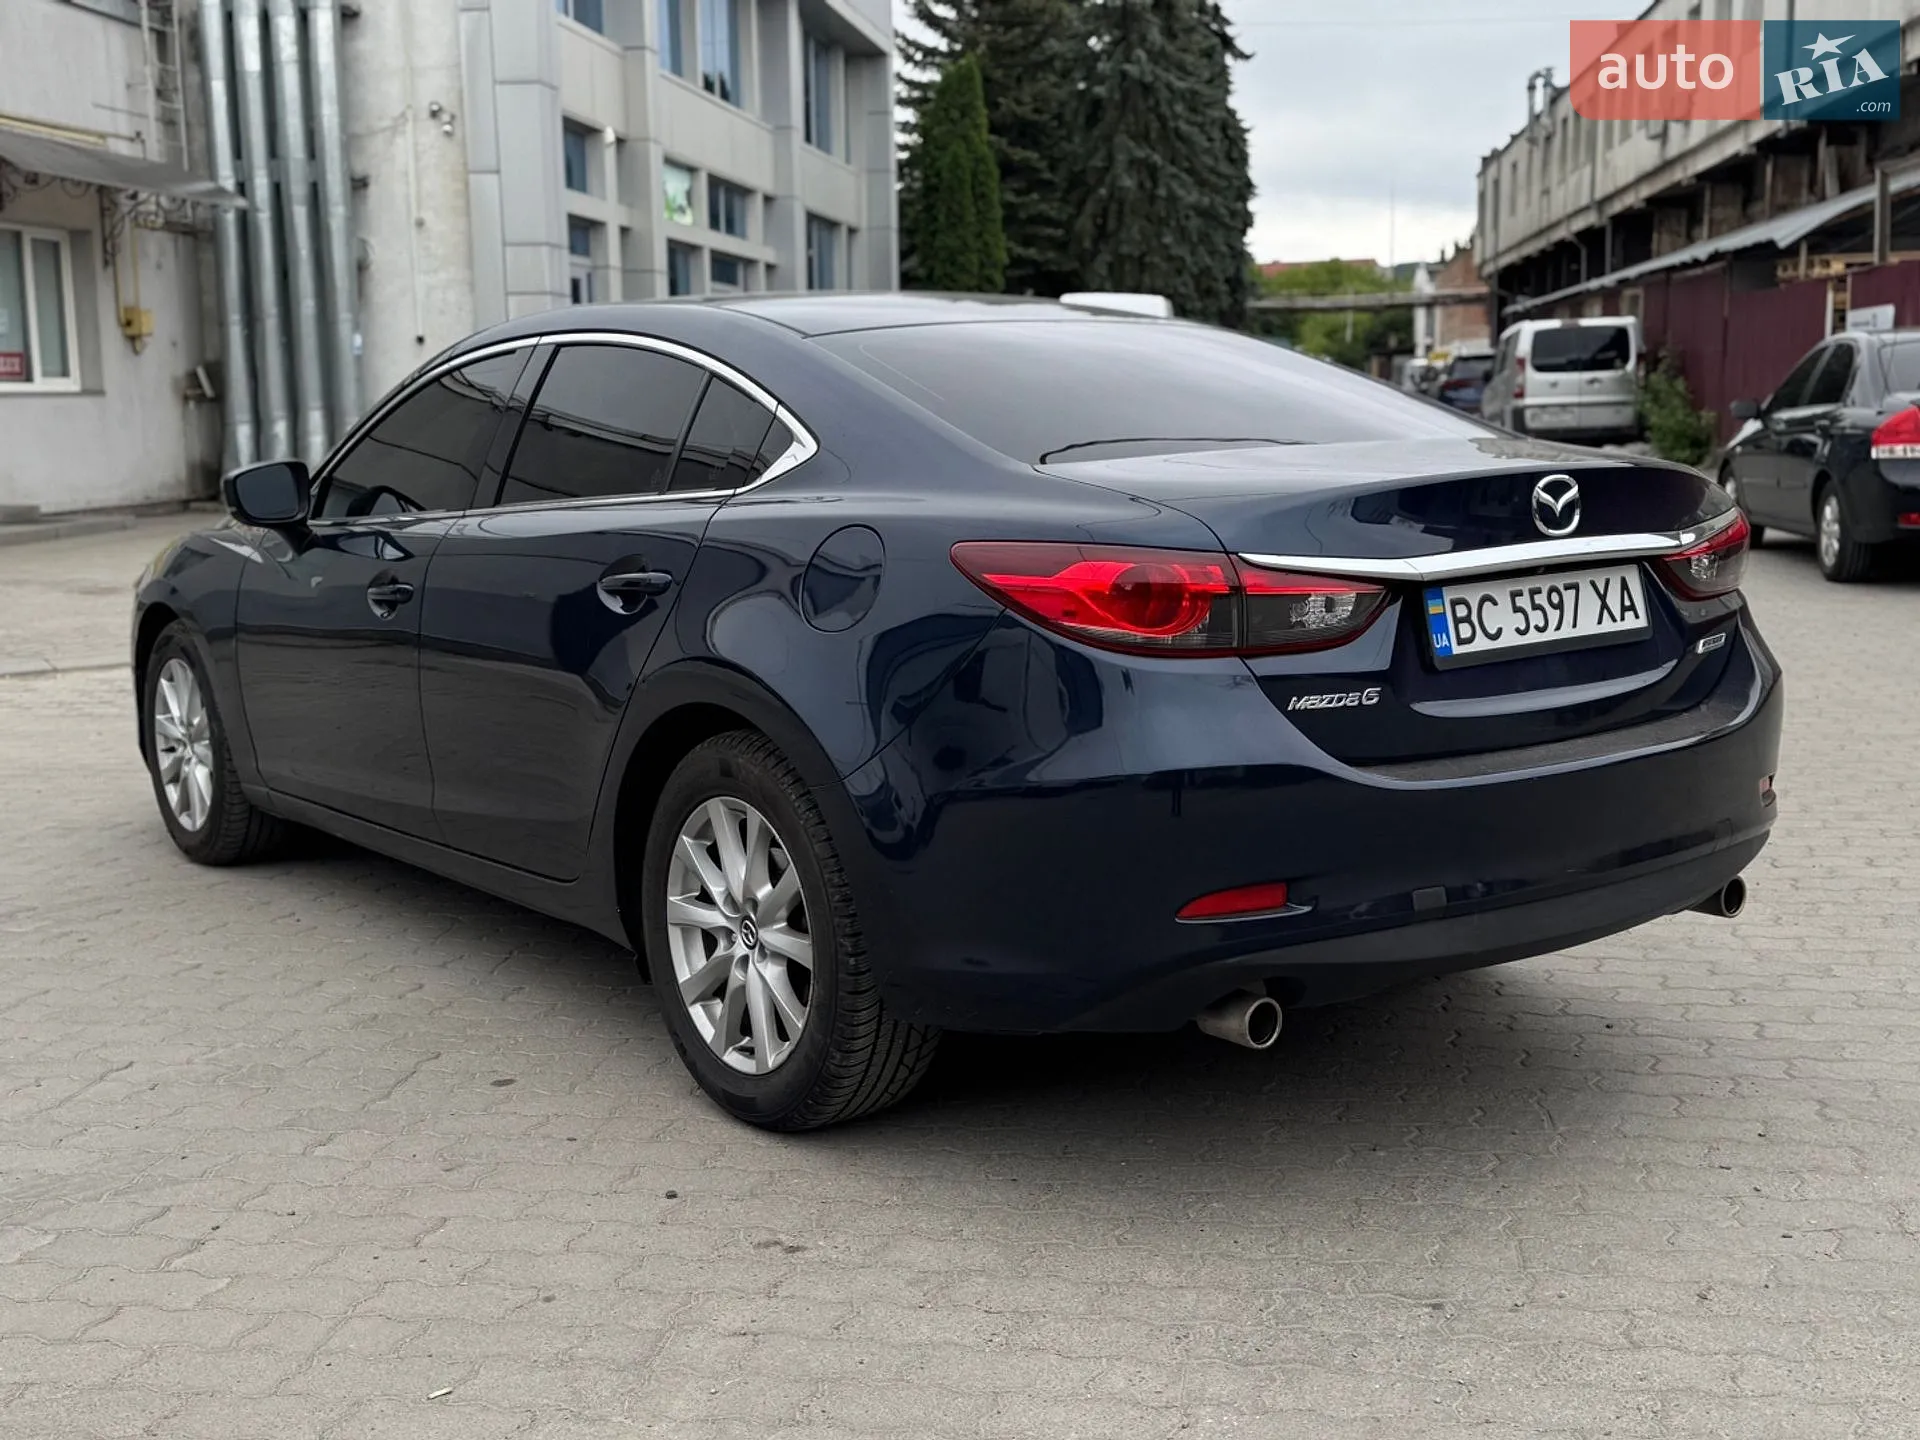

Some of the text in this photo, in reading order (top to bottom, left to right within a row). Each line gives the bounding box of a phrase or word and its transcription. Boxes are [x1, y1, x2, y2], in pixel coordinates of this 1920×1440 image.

[1450, 575, 1640, 646] BC 5597 XA
[1433, 632, 1450, 648] UA
